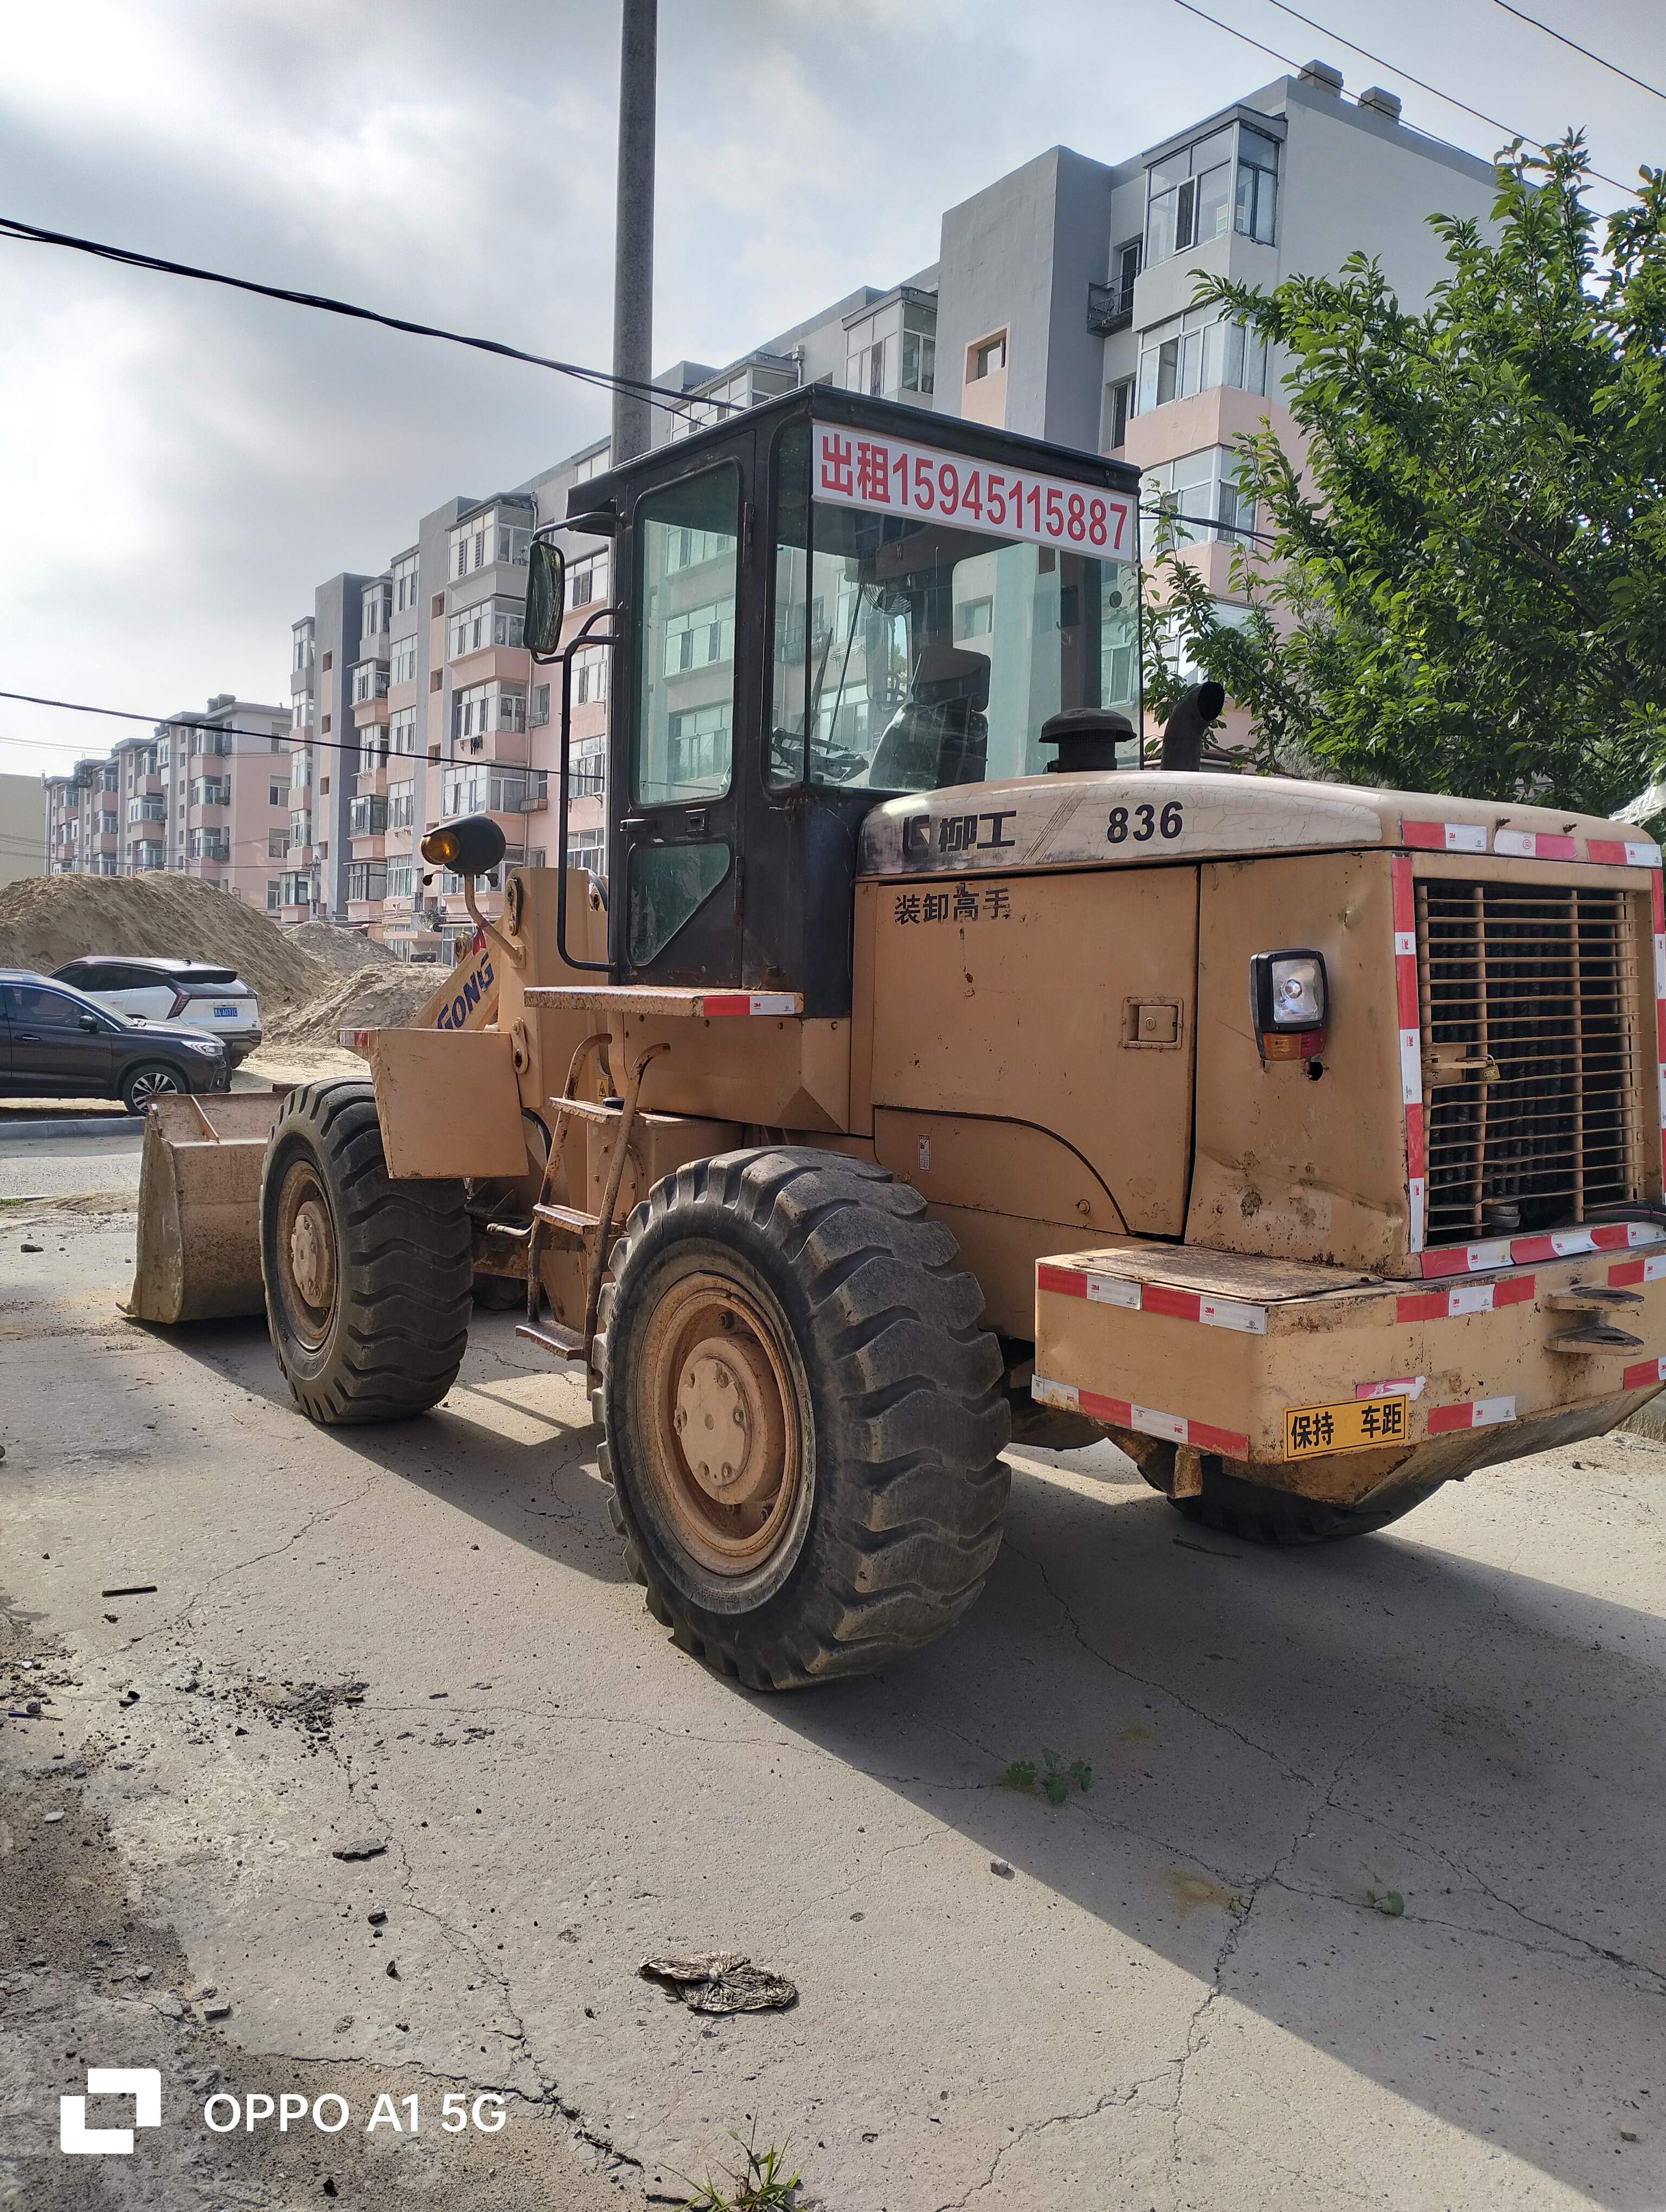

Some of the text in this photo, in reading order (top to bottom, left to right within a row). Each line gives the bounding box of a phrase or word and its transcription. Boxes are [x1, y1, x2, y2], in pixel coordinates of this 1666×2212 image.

[938, 801, 1183, 853] 柳工 836
[894, 882, 1011, 925] 装卸高手
[1290, 1402, 1403, 1450] 保持 车距
